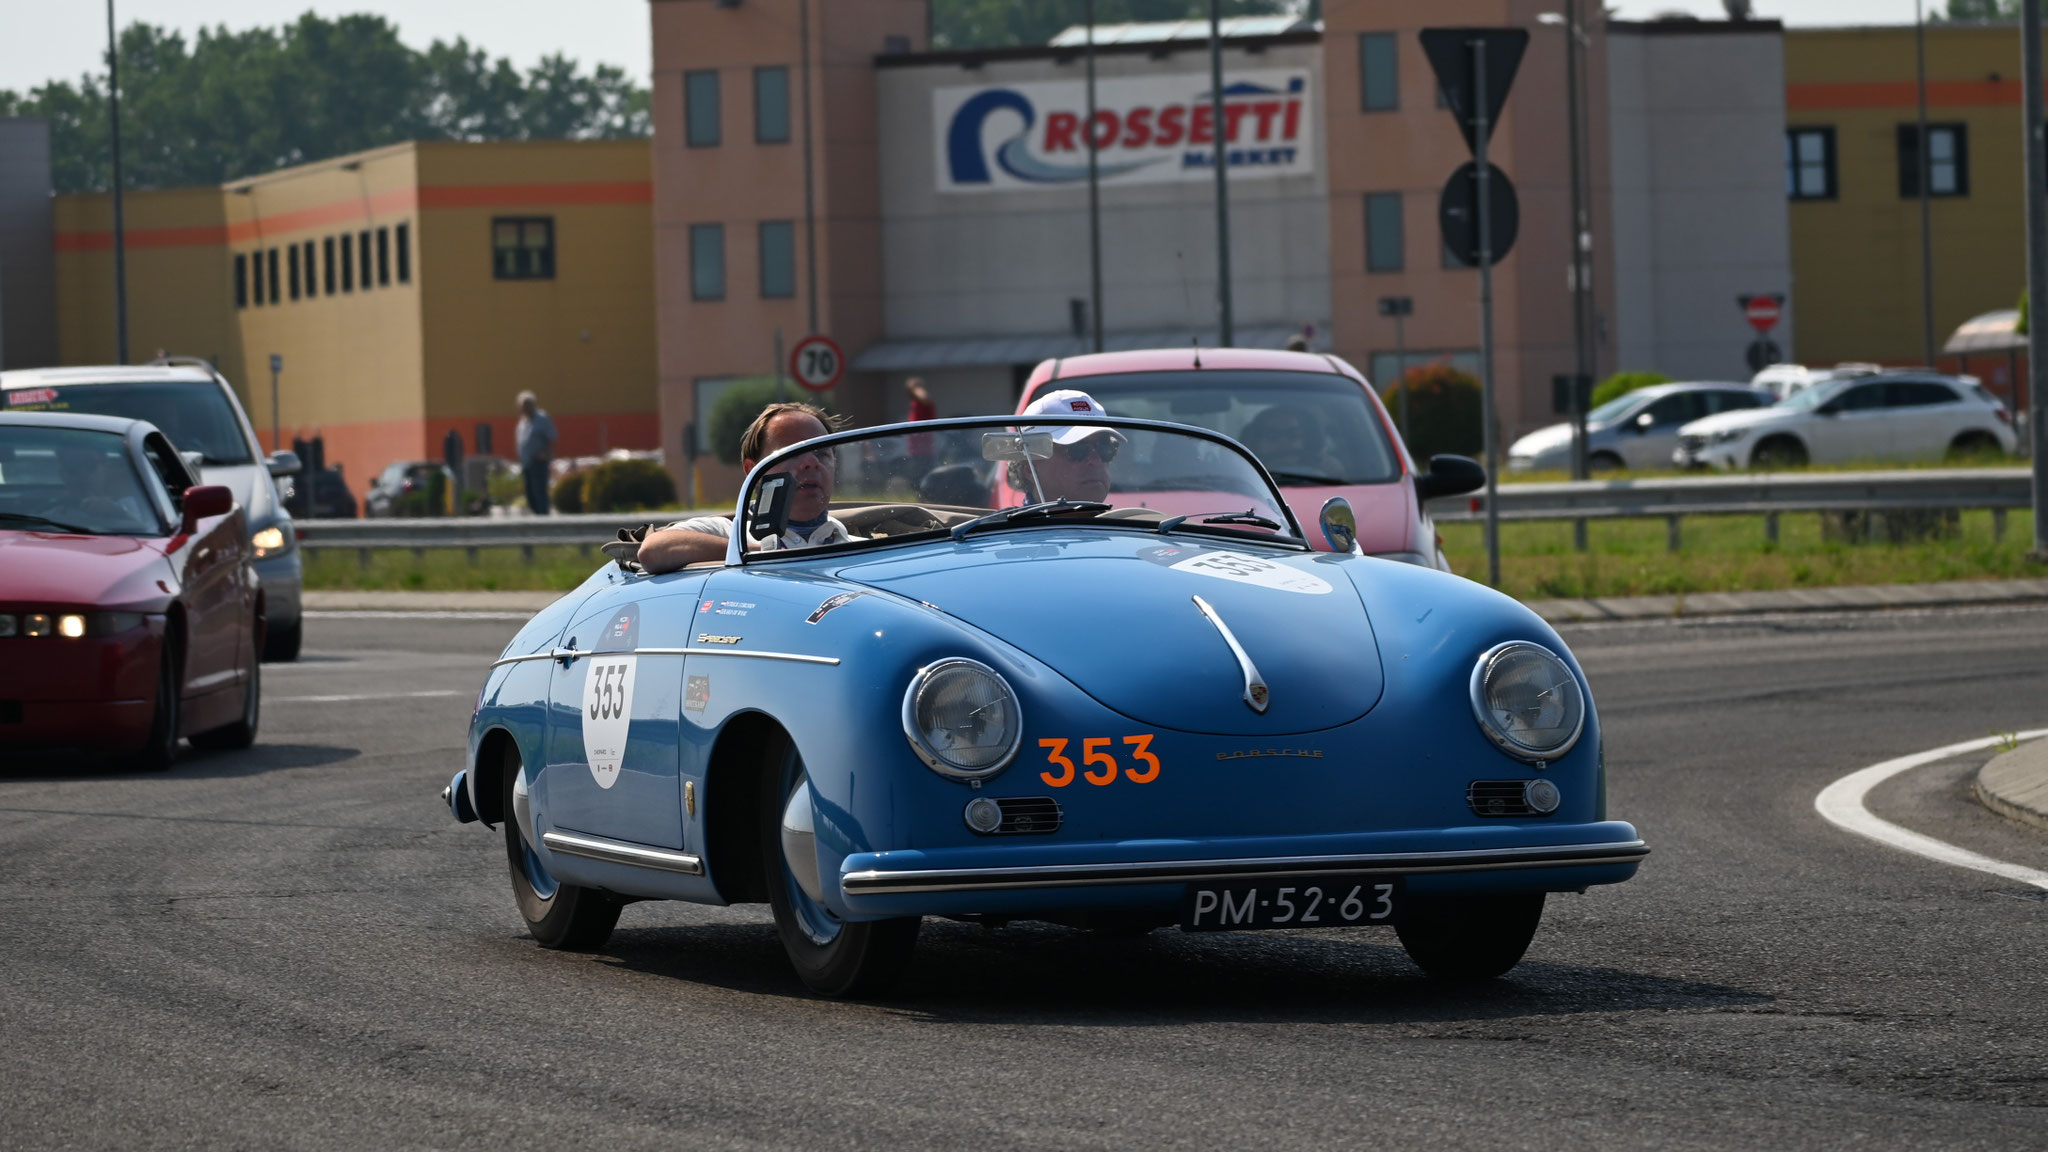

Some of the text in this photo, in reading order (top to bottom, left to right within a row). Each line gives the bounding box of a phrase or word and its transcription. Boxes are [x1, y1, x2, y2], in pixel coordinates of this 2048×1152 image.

[1043, 100, 1302, 153] ROSSETTI
[803, 350, 834, 378] 70
[1192, 555, 1276, 577] 353
[590, 664, 628, 721] 353
[1037, 733, 1161, 788] 353
[1216, 748, 1324, 760] PORSCHE
